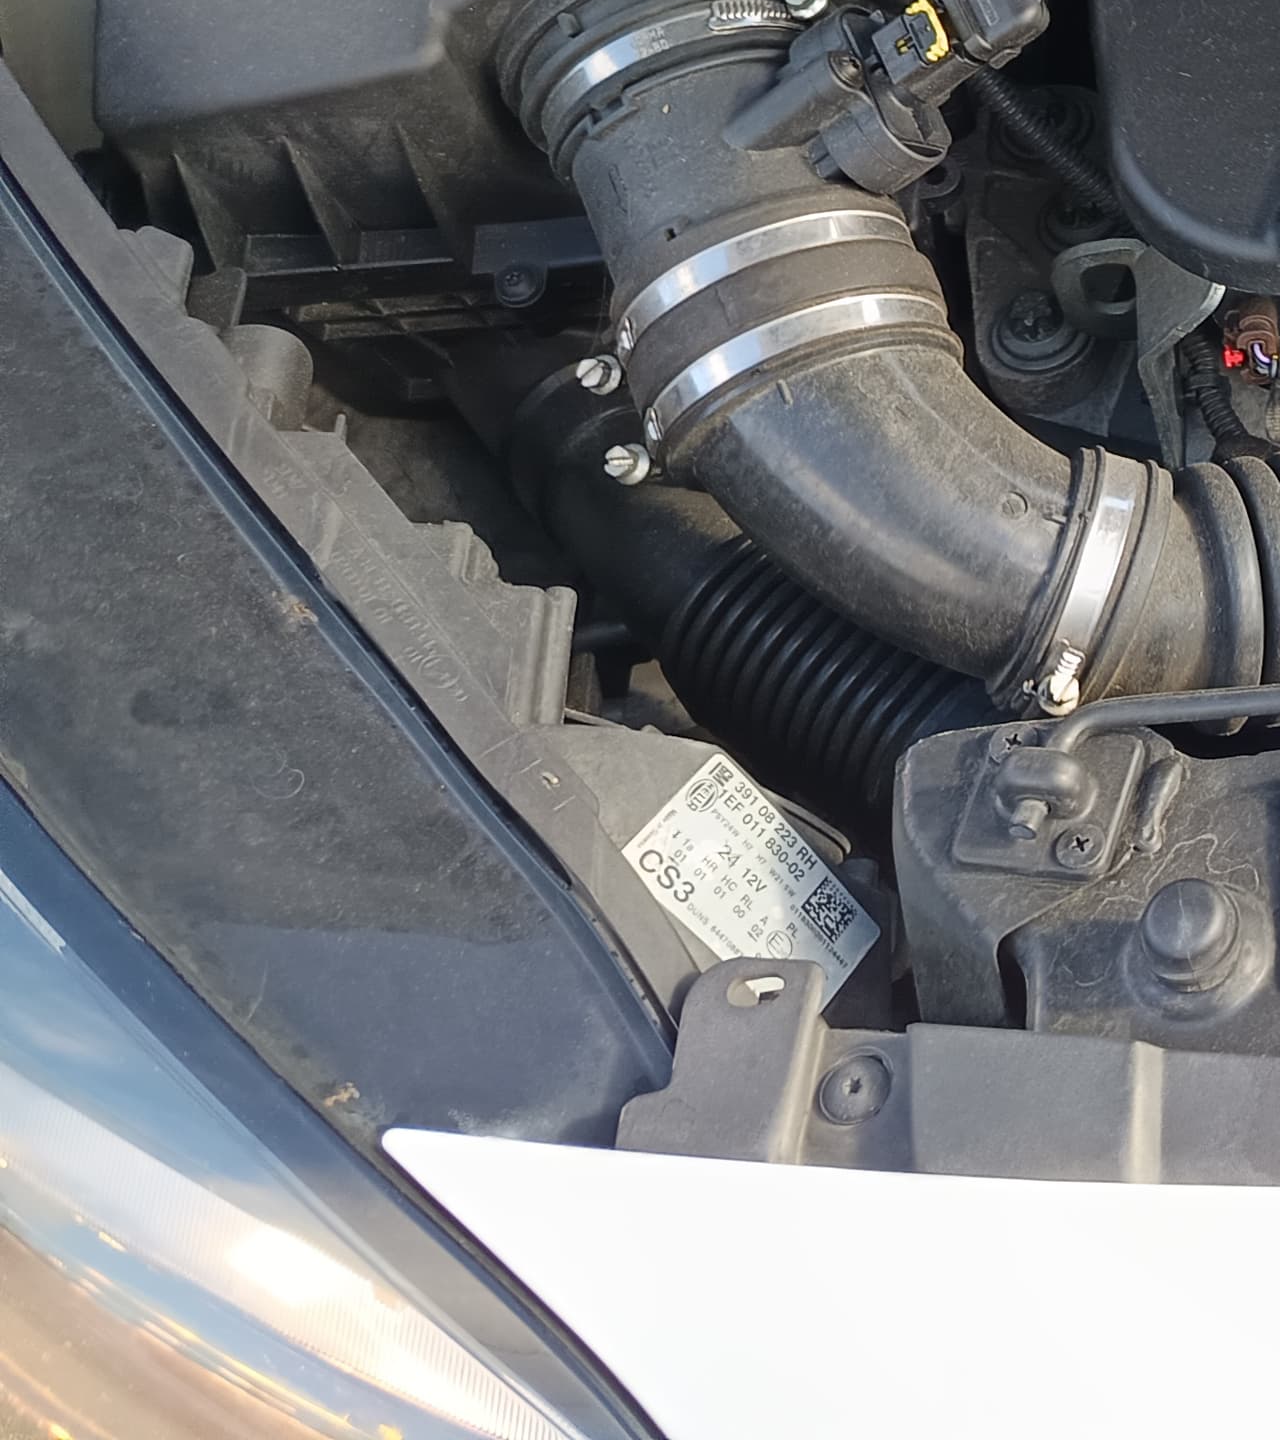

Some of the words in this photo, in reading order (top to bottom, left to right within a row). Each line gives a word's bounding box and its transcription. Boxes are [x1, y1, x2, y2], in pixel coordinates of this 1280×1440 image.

[717, 787, 744, 815] 1EF
[741, 812, 766, 839] 011
[763, 837, 806, 882] 830-02
[733, 781, 758, 806] 391
[756, 805, 775, 824] 08
[774, 824, 797, 848] 223
[795, 848, 816, 869] RH
[638, 846, 694, 904] CS3
[672, 849, 686, 862] 01
[693, 866, 707, 880] 01
[712, 886, 726, 900] 01
[731, 904, 745, 919] 00
[750, 923, 764, 937] 02
[702, 856, 718, 872] HR
[720, 875, 737, 892] HC
[739, 895, 755, 911] RL
[739, 867, 766, 895] 12V
